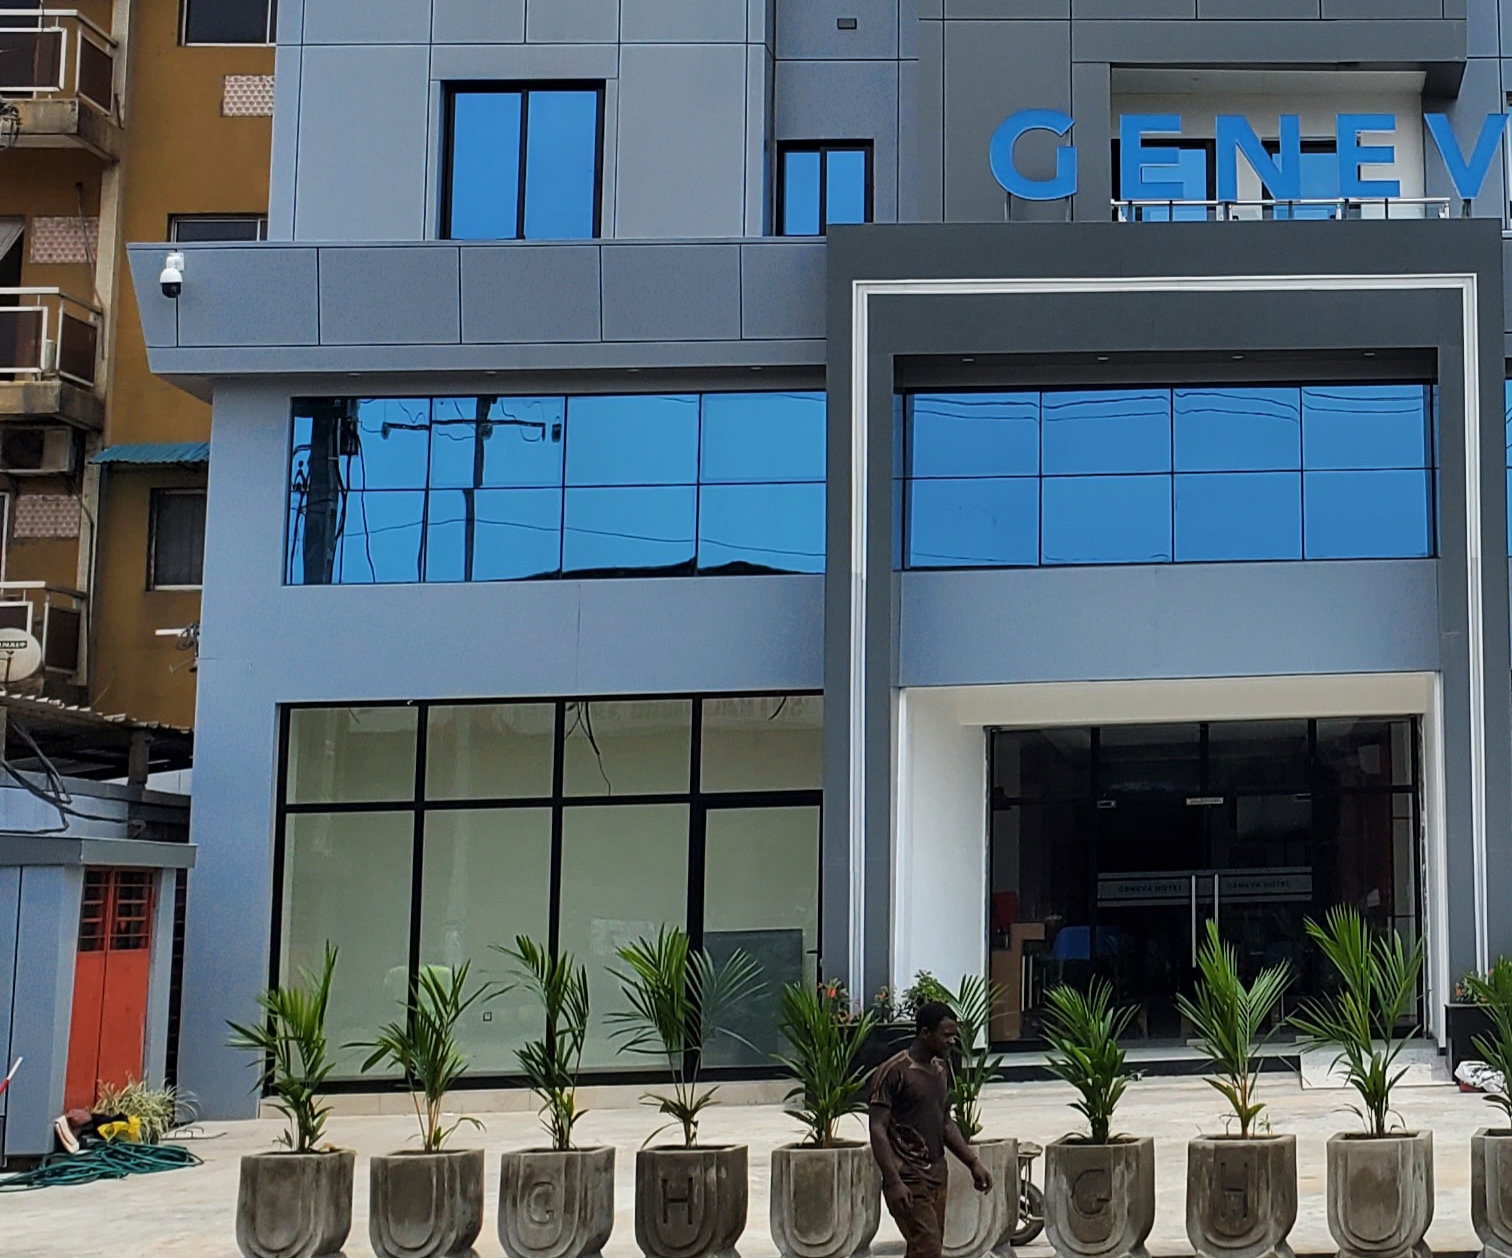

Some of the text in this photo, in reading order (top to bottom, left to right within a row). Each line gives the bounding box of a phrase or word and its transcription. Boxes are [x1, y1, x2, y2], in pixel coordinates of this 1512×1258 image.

[526, 1181, 556, 1226] G
[662, 1176, 694, 1226] H
[1071, 1168, 1111, 1218] G
